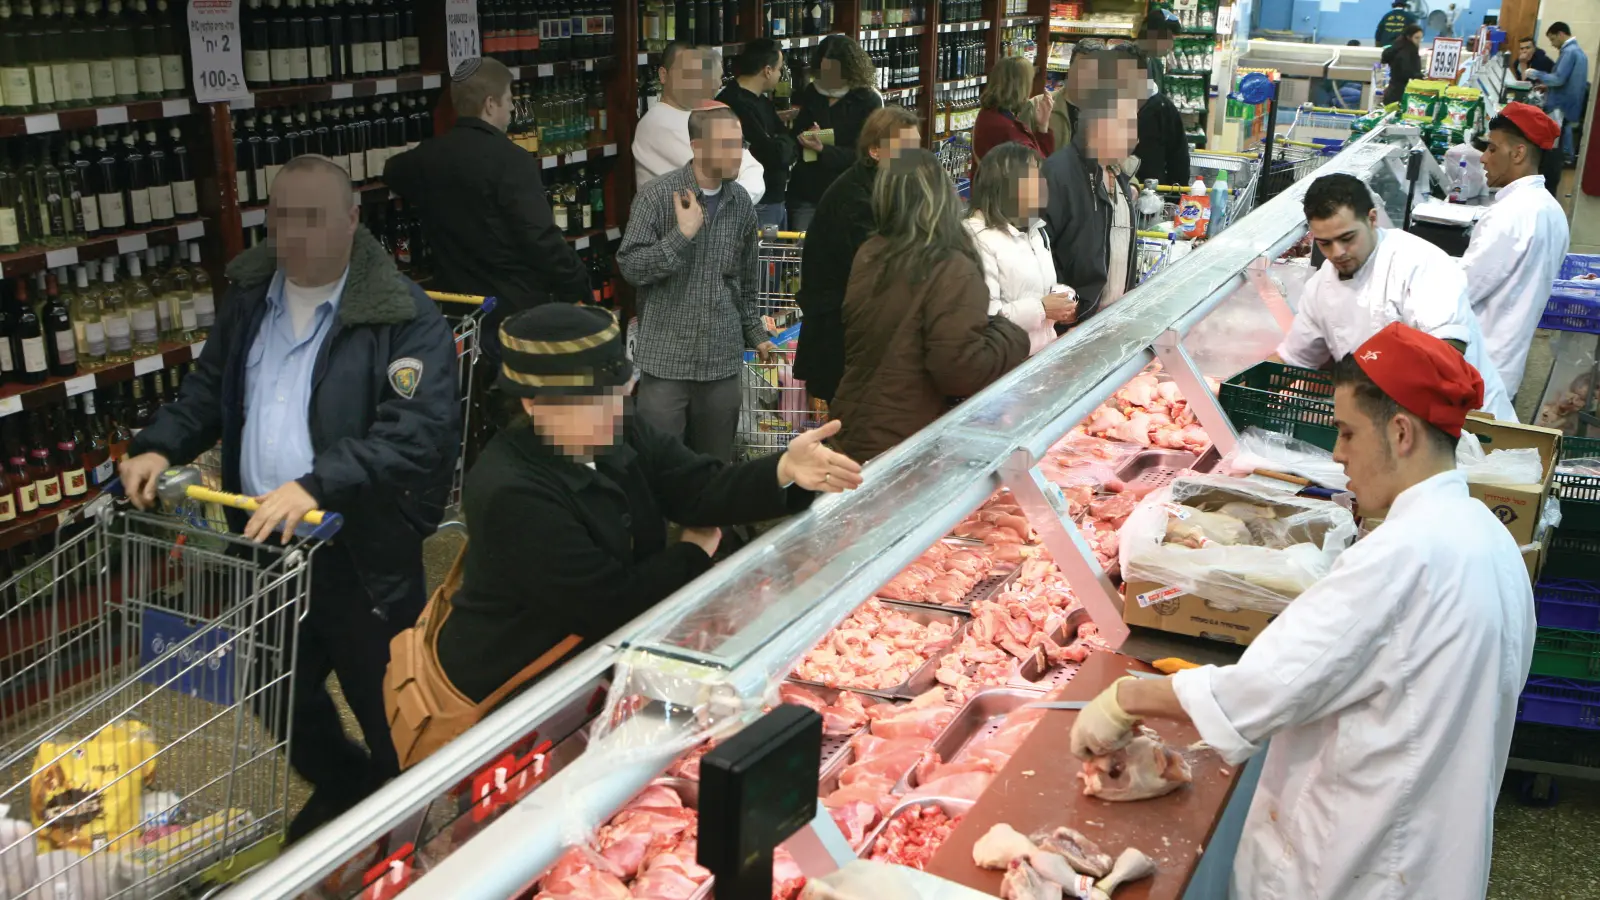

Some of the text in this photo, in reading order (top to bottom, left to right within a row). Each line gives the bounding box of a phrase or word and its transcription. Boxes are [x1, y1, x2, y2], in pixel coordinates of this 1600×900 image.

[201, 34, 231, 54] 2 יח'
[200, 69, 240, 88] ב-100
